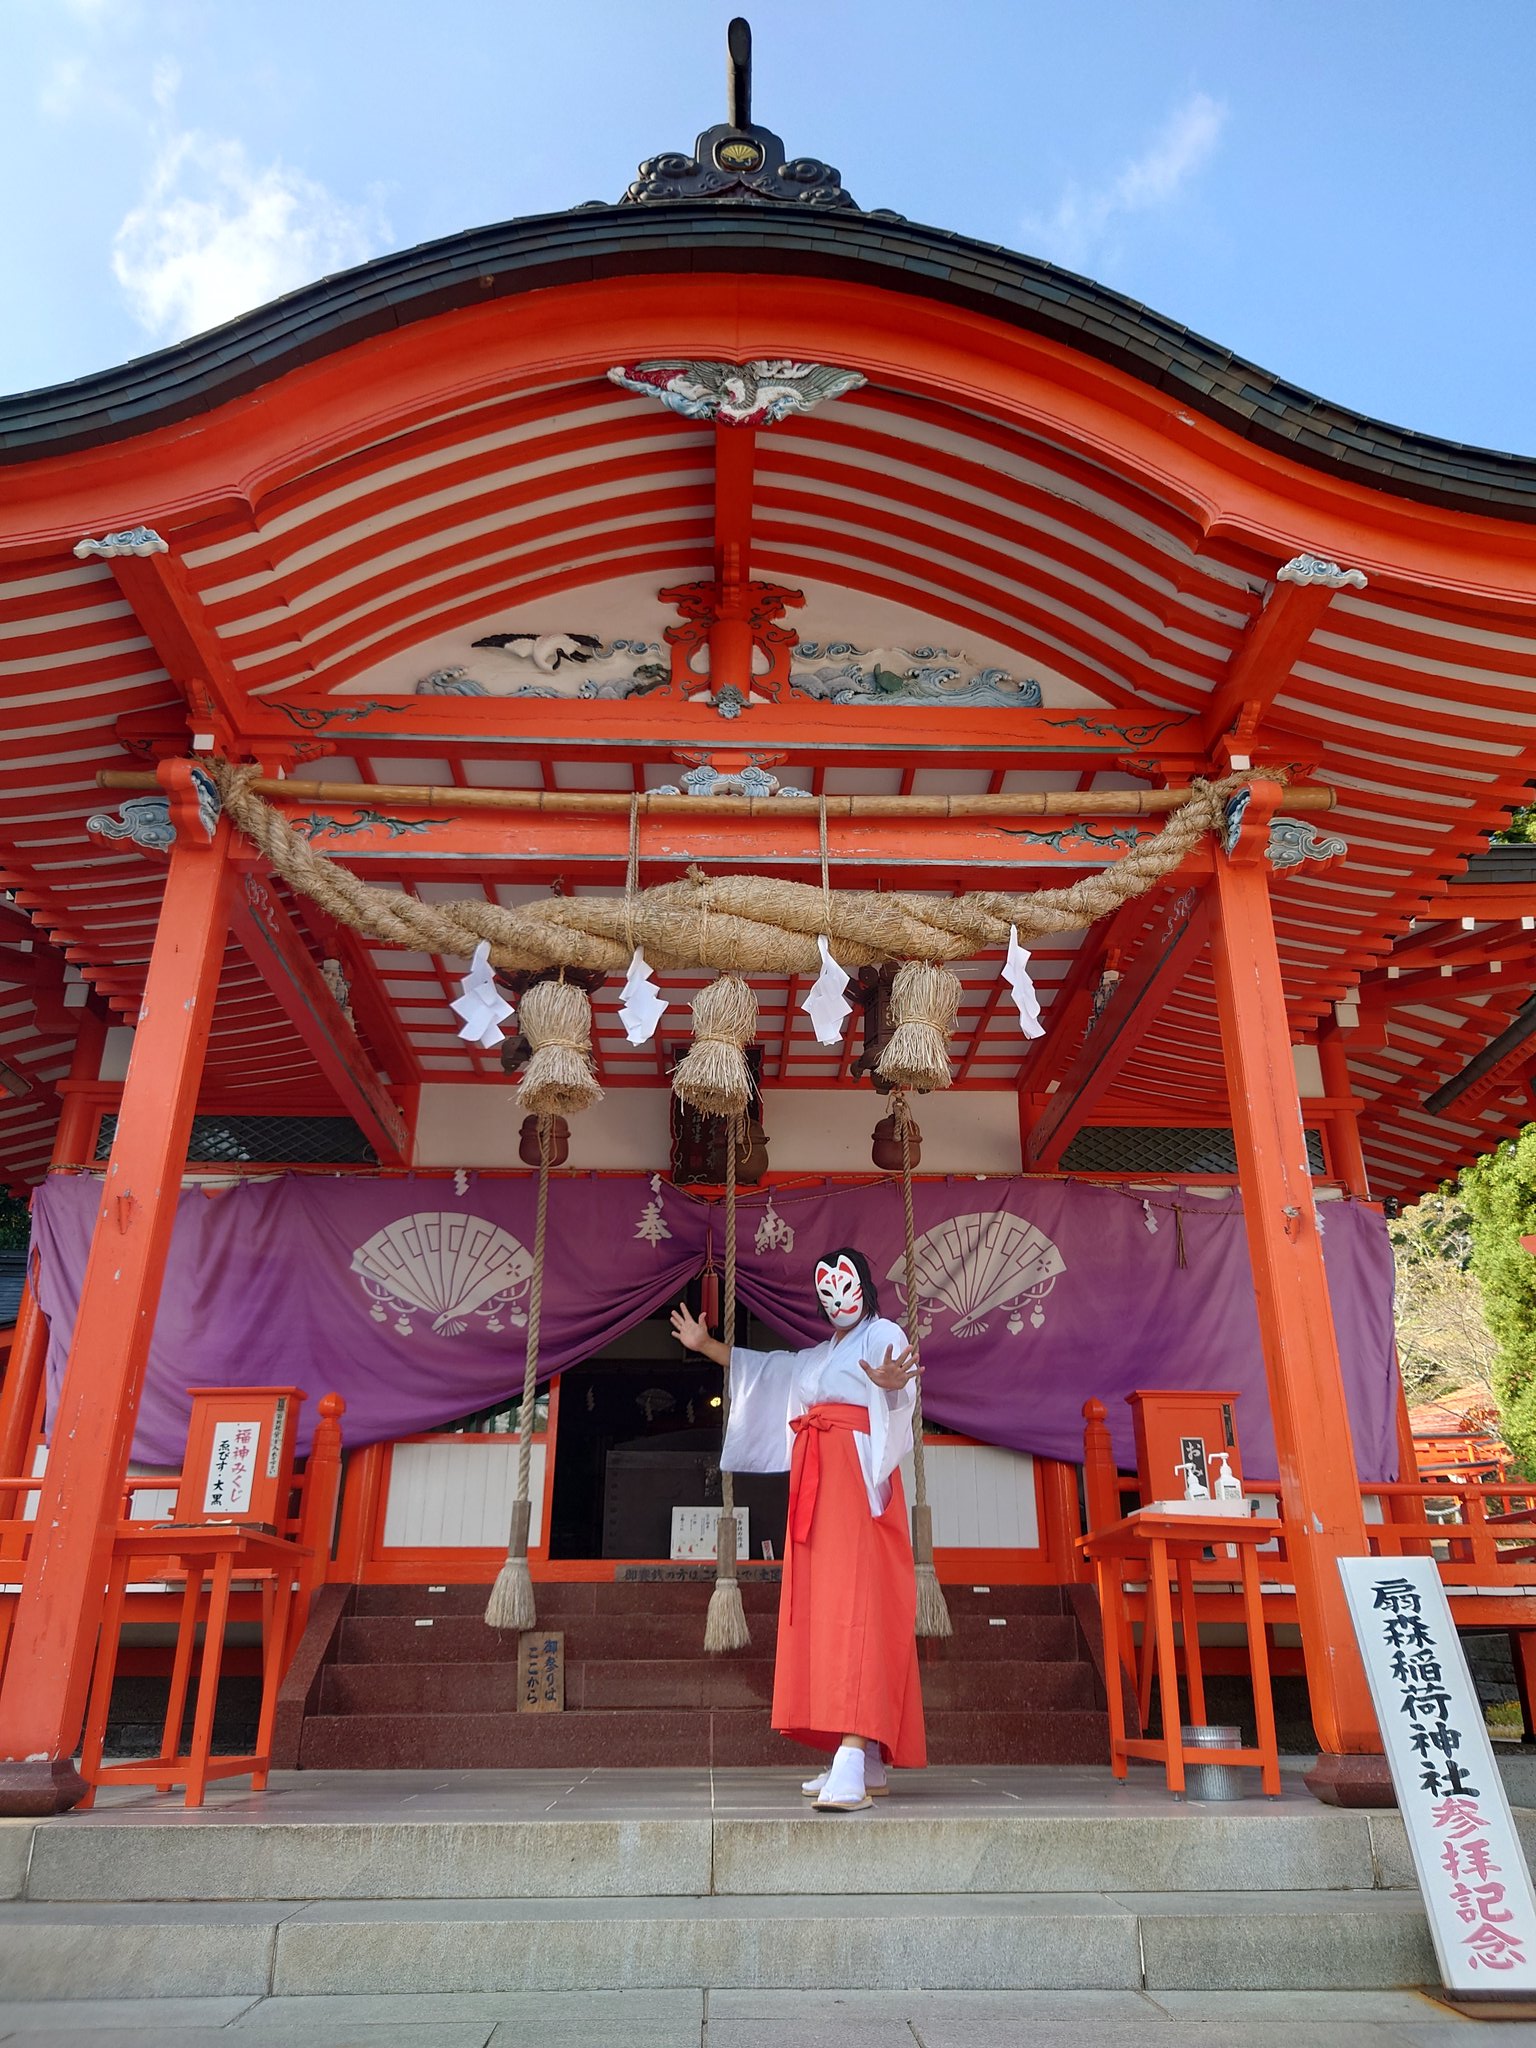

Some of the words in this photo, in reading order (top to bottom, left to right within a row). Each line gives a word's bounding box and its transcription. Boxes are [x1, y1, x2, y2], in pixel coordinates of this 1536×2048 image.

[633, 1201, 673, 1249] 奉
[754, 1215, 796, 1256] 納
[231, 1428, 252, 1503] 福神みくじ
[526, 1646, 539, 1704] ここから
[543, 1639, 559, 1702] 御参りは
